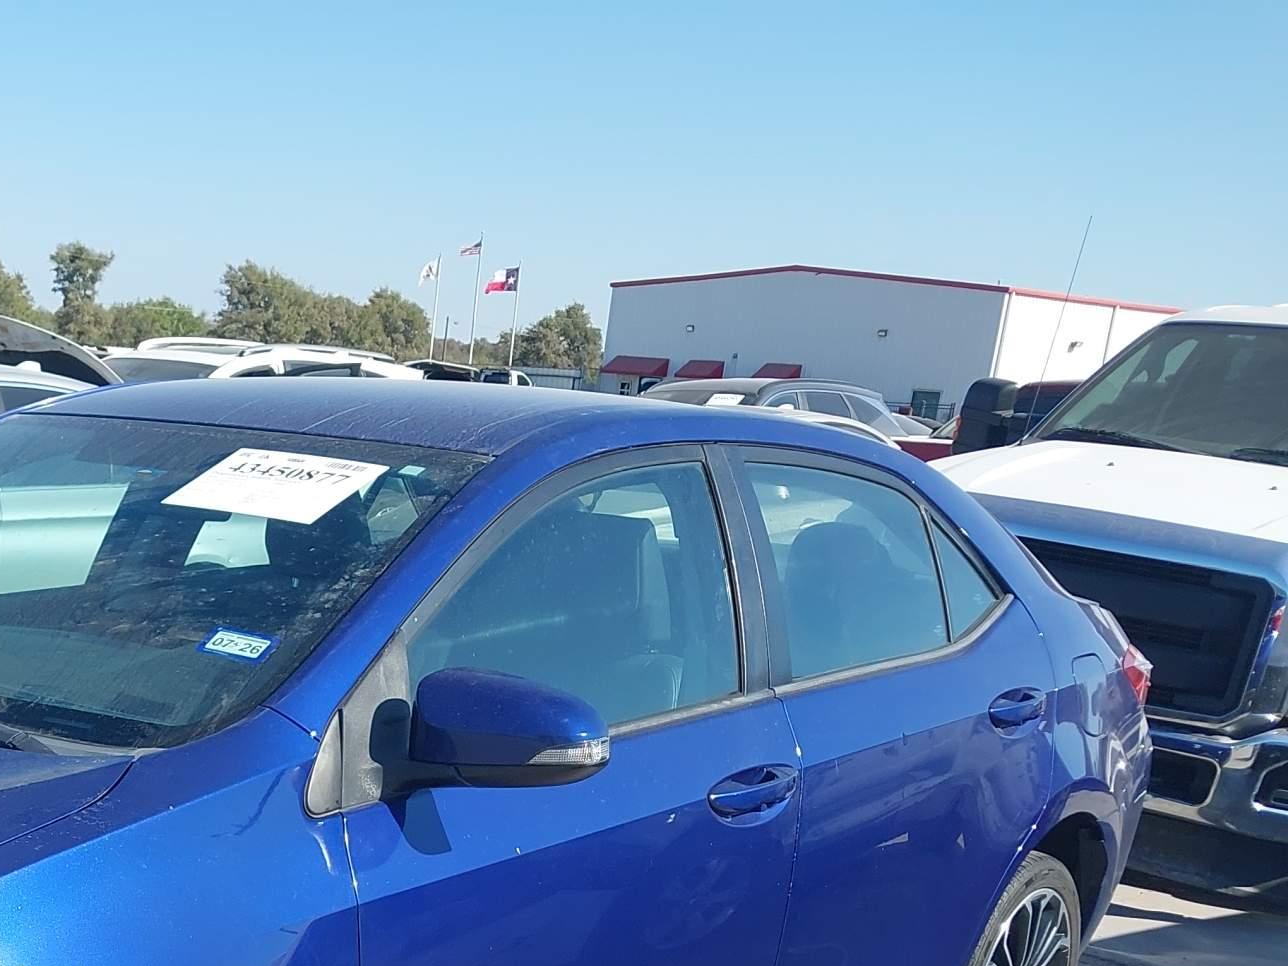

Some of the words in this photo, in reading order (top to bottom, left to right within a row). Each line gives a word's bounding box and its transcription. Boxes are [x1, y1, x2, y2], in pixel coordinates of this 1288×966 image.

[229, 461, 352, 485] 43450877
[211, 637, 235, 648] 07
[238, 642, 263, 655] 26
